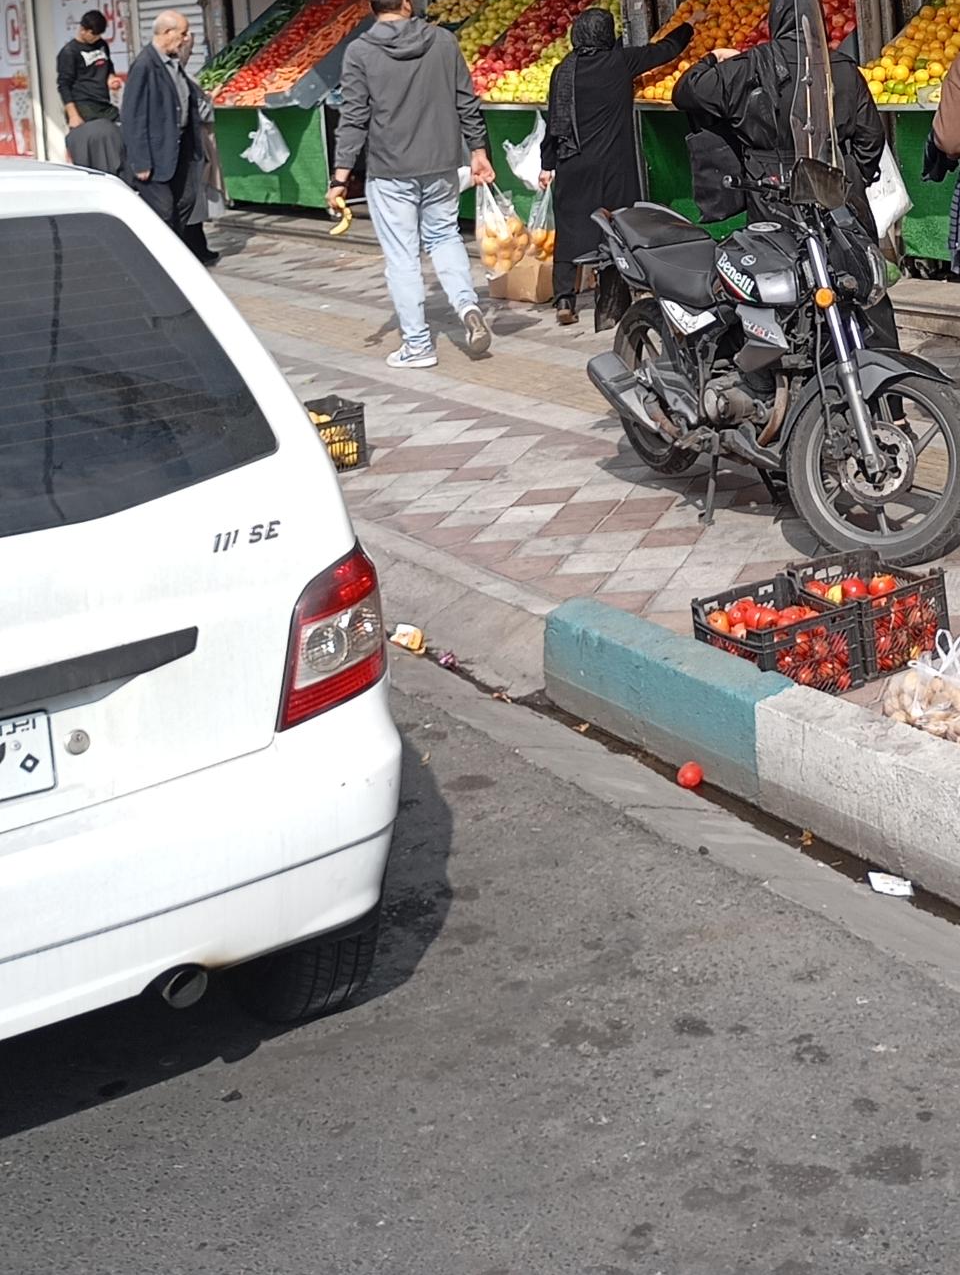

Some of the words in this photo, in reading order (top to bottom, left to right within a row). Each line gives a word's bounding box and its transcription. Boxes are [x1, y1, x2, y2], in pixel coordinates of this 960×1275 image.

[716, 251, 755, 295] Benelli
[213, 528, 240, 554] 111
[248, 519, 282, 545] SE
